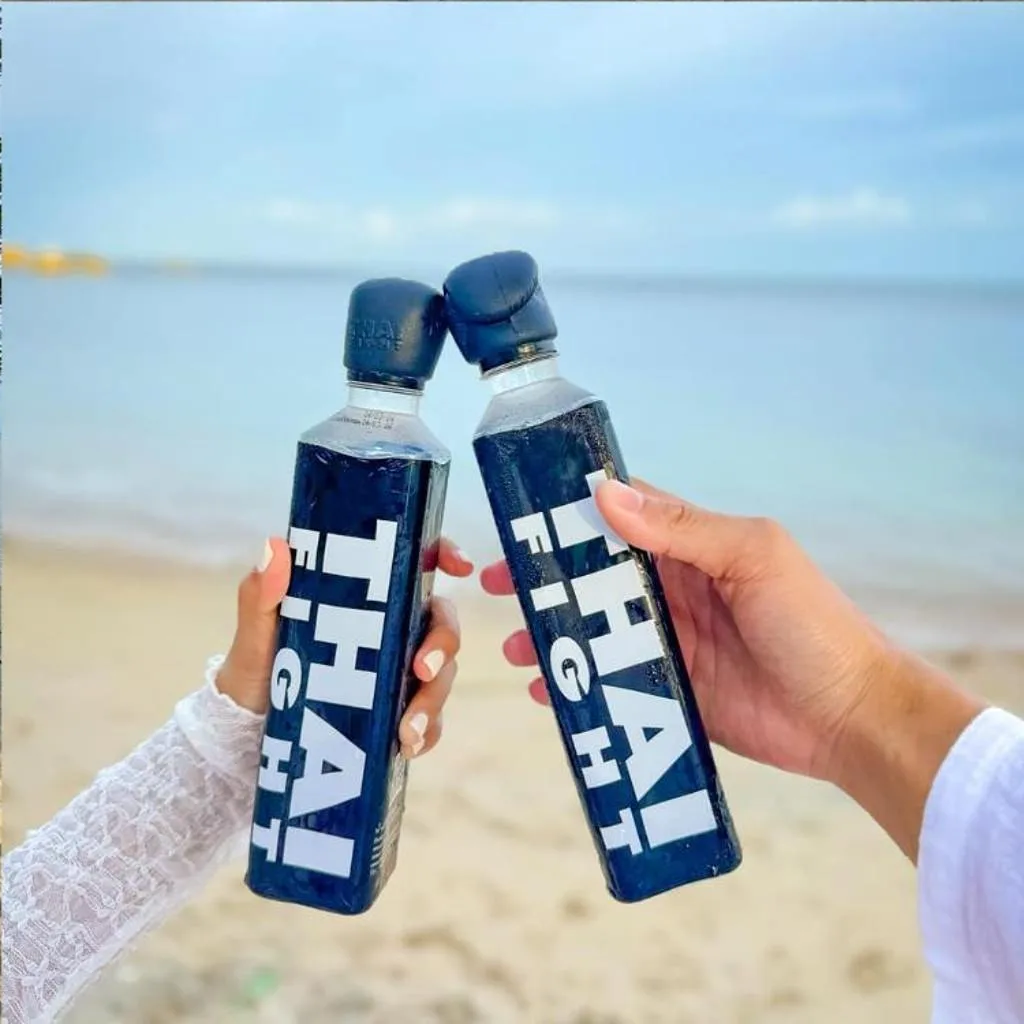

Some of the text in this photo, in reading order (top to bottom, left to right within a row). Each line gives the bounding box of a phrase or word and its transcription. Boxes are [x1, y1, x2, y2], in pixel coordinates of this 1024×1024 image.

[250, 527, 320, 861] FIGHT
[283, 519, 397, 877] THAI
[510, 512, 643, 856] FIGHT
[550, 469, 719, 850] THAI
